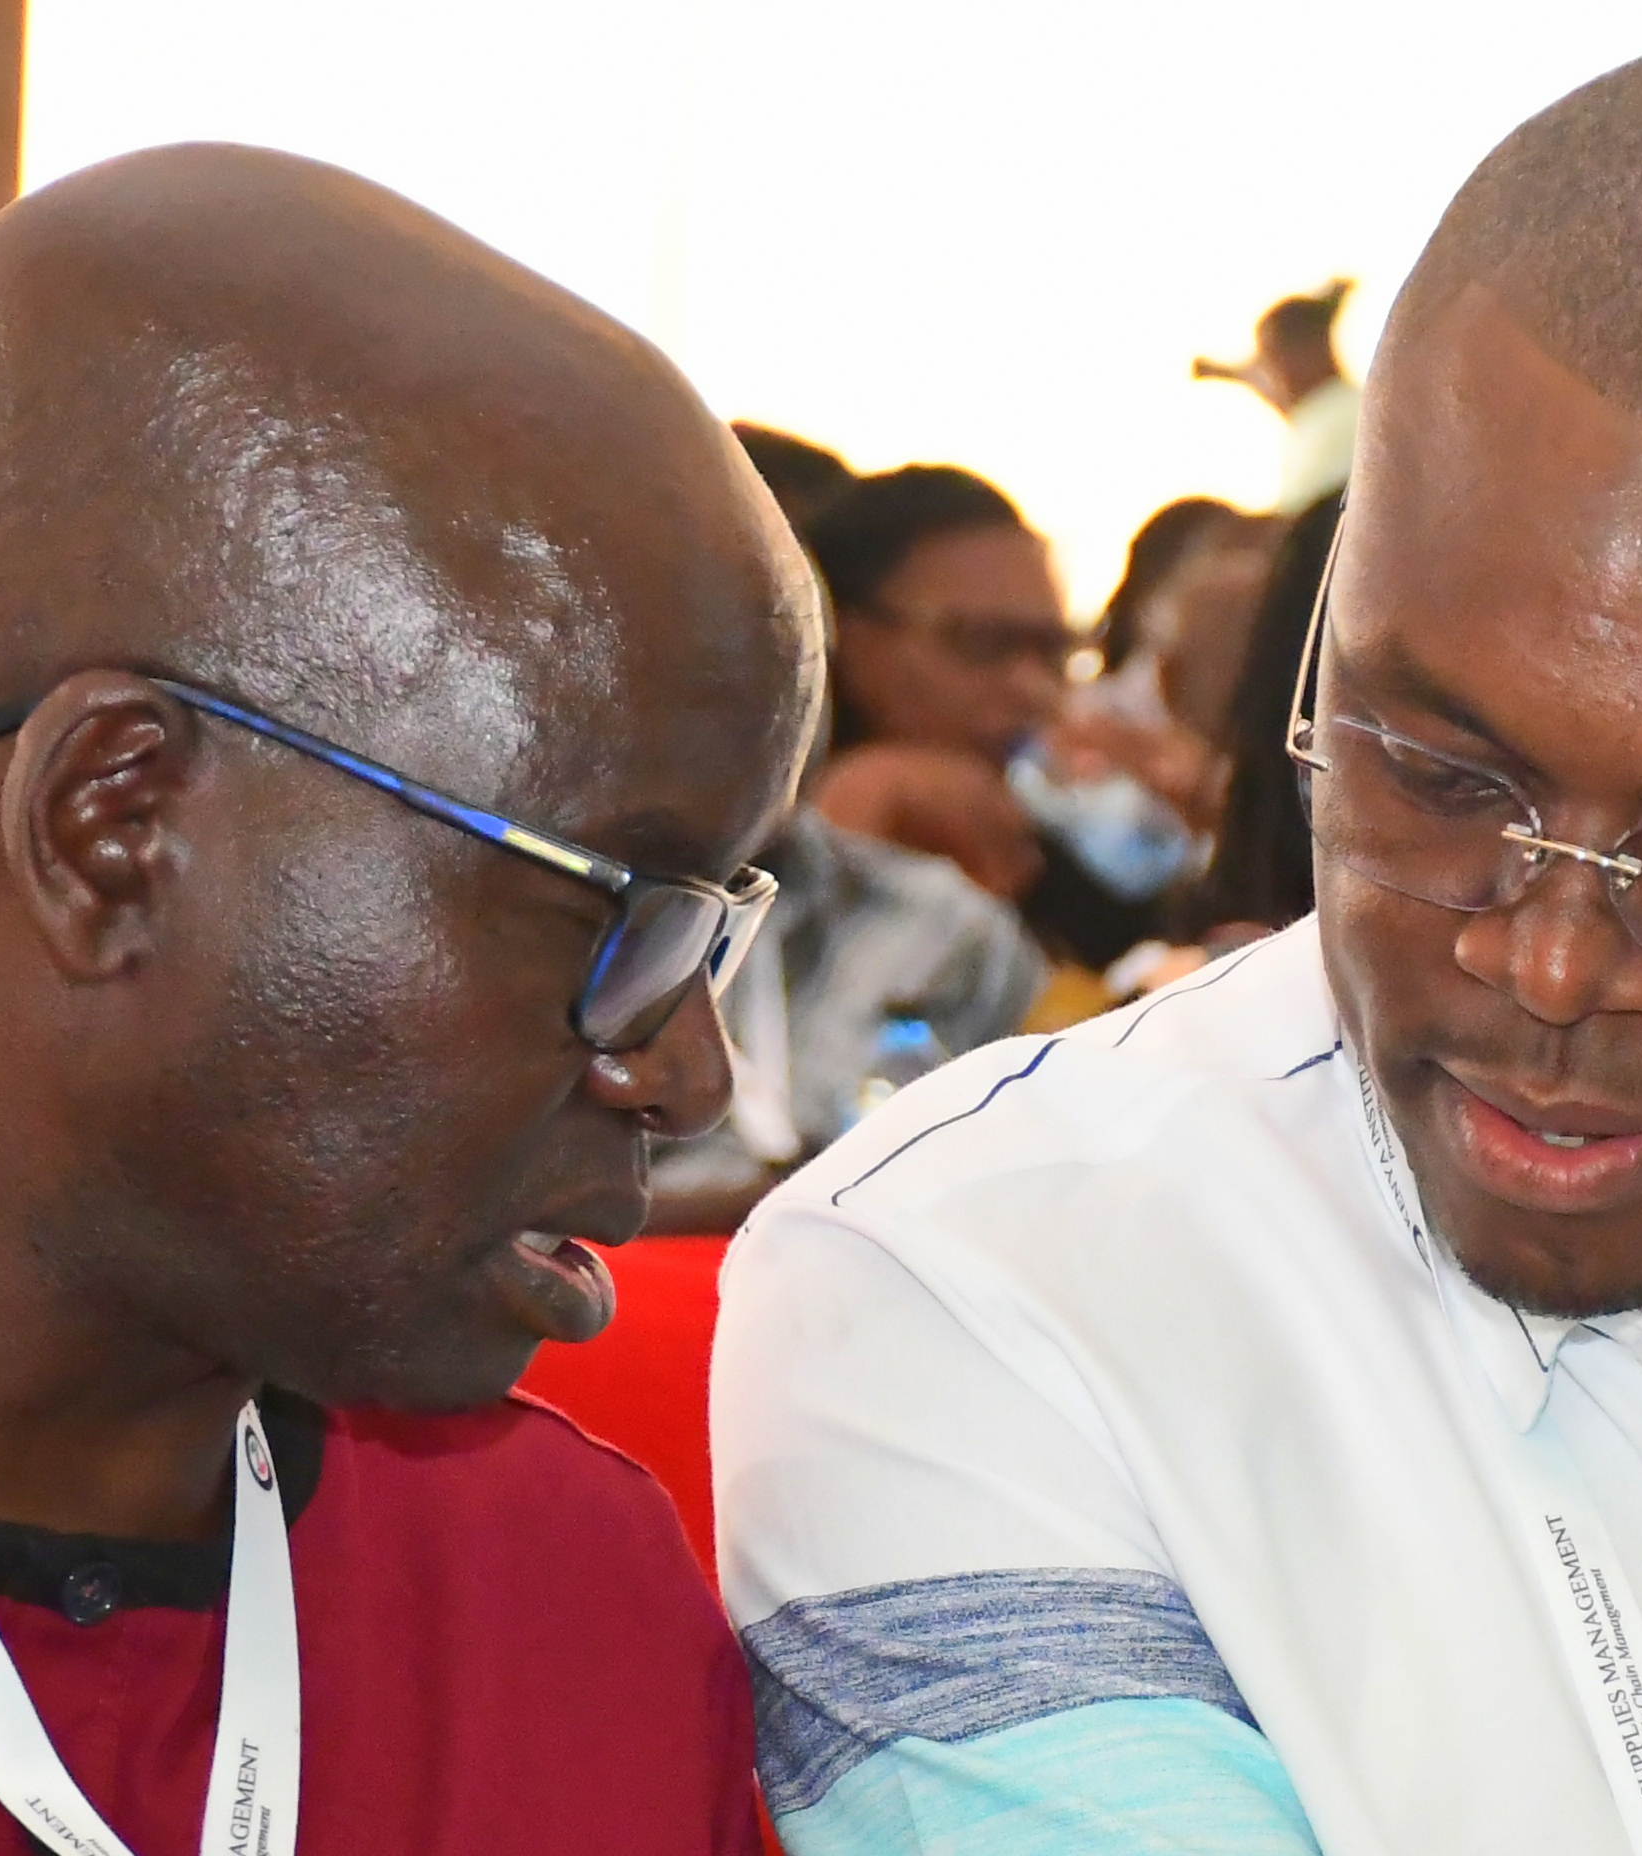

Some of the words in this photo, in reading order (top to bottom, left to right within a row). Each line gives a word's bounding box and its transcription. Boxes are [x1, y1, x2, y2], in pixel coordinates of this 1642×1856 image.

[1380, 1149, 1411, 1228] KENYA
[1544, 1514, 1620, 1685] MANAGEMENT
[1590, 1567, 1633, 1661] Management
